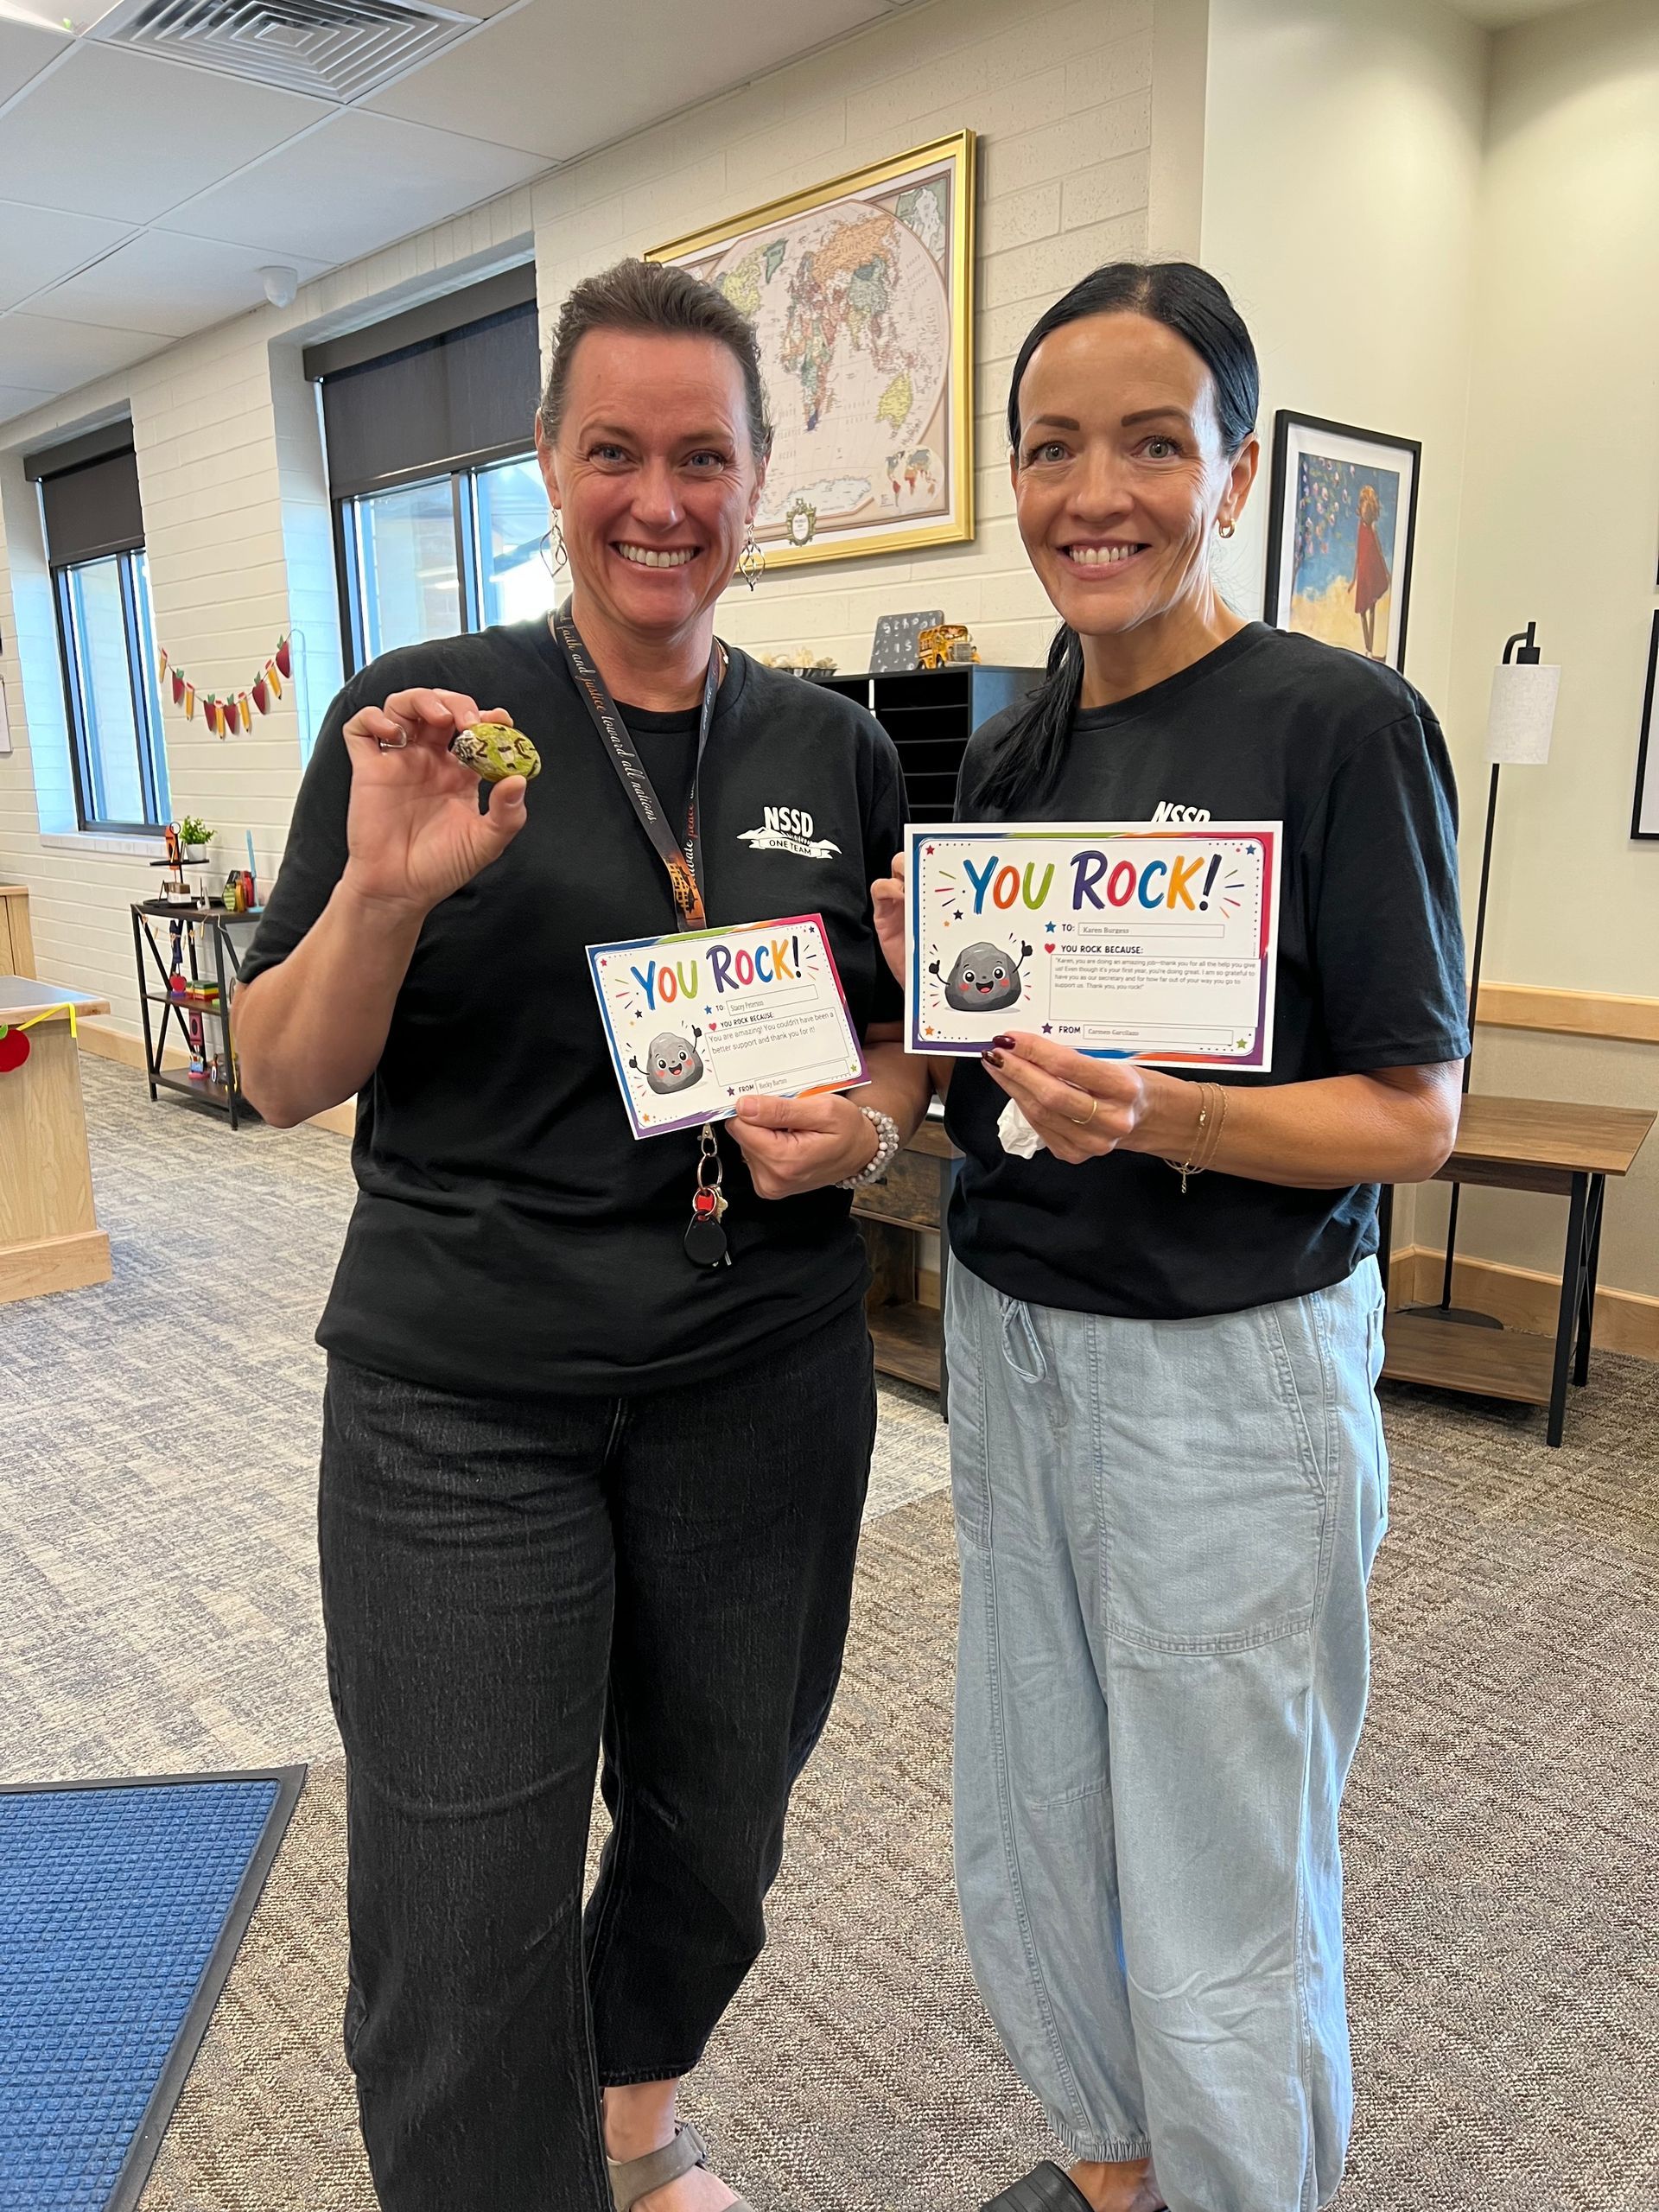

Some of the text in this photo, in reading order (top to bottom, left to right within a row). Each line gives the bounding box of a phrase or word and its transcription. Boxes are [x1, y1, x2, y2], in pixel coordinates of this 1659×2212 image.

[556, 624, 582, 652] faith
[572, 653, 596, 675] and
[575, 675, 607, 713] justice
[601, 715, 636, 758] toward
[621, 760, 645, 780] all
[763, 806, 814, 838] NSSD
[769, 839, 811, 855] ONE TEAM
[963, 849, 1223, 915] YOU ROCK!
[1062, 924, 1075, 932] TO:
[1061, 944, 1077, 953] YOU
[1104, 945, 1144, 954] BECAUSE:
[630, 935, 803, 1011] YOU ROCK!
[733, 1017, 749, 1026] ROCK
[734, 1026, 763, 1038] amazing!
[763, 1023, 776, 1032] You
[776, 1019, 800, 1029] couldn't
[799, 1015, 814, 1024] have
[814, 1013, 830, 1021] been
[1058, 1025, 1081, 1034] FROM
[711, 1046, 732, 1055] better
[733, 1038, 758, 1050] support
[758, 1035, 770, 1044] and
[770, 1033, 788, 1042] thank
[787, 1031, 799, 1039] you
[738, 1084, 755, 1093] FROM
